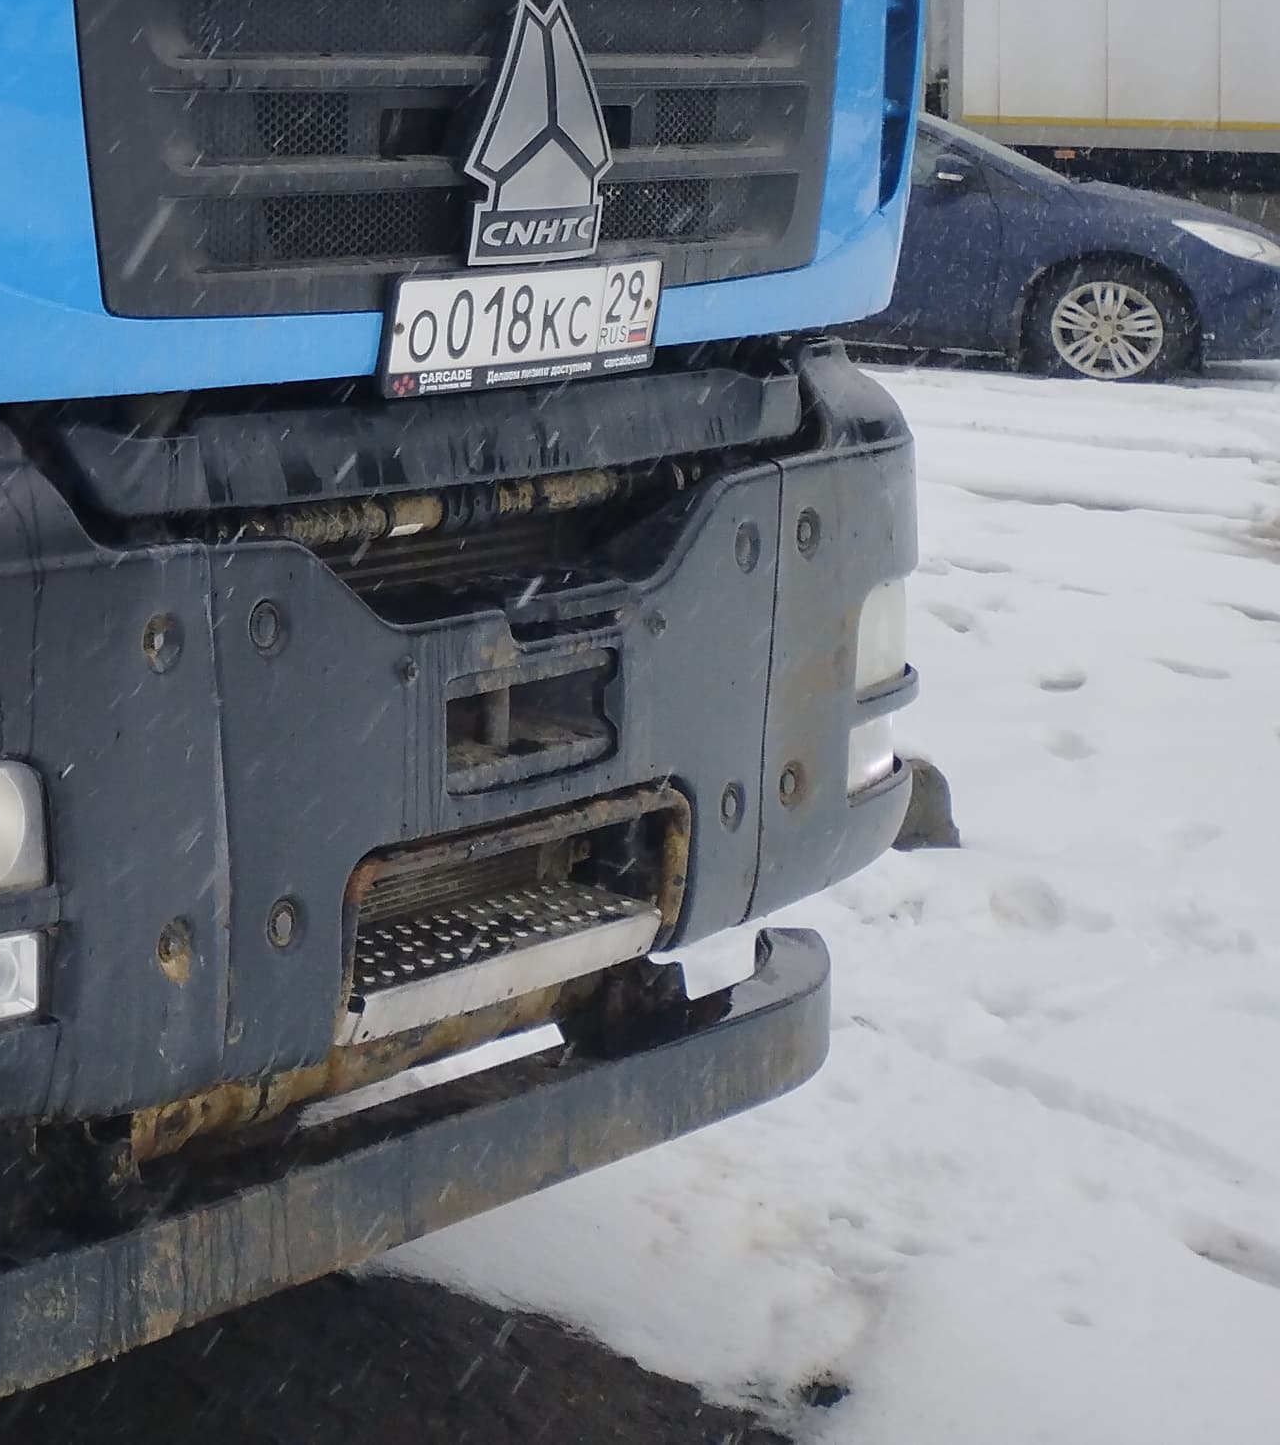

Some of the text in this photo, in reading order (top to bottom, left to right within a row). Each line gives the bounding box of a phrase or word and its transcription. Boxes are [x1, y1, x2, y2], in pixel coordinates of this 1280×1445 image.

[482, 216, 595, 247] CNHTC
[407, 269, 646, 363] О018КС 29
[599, 325, 627, 347] RUS
[419, 368, 473, 385] CARCADE
